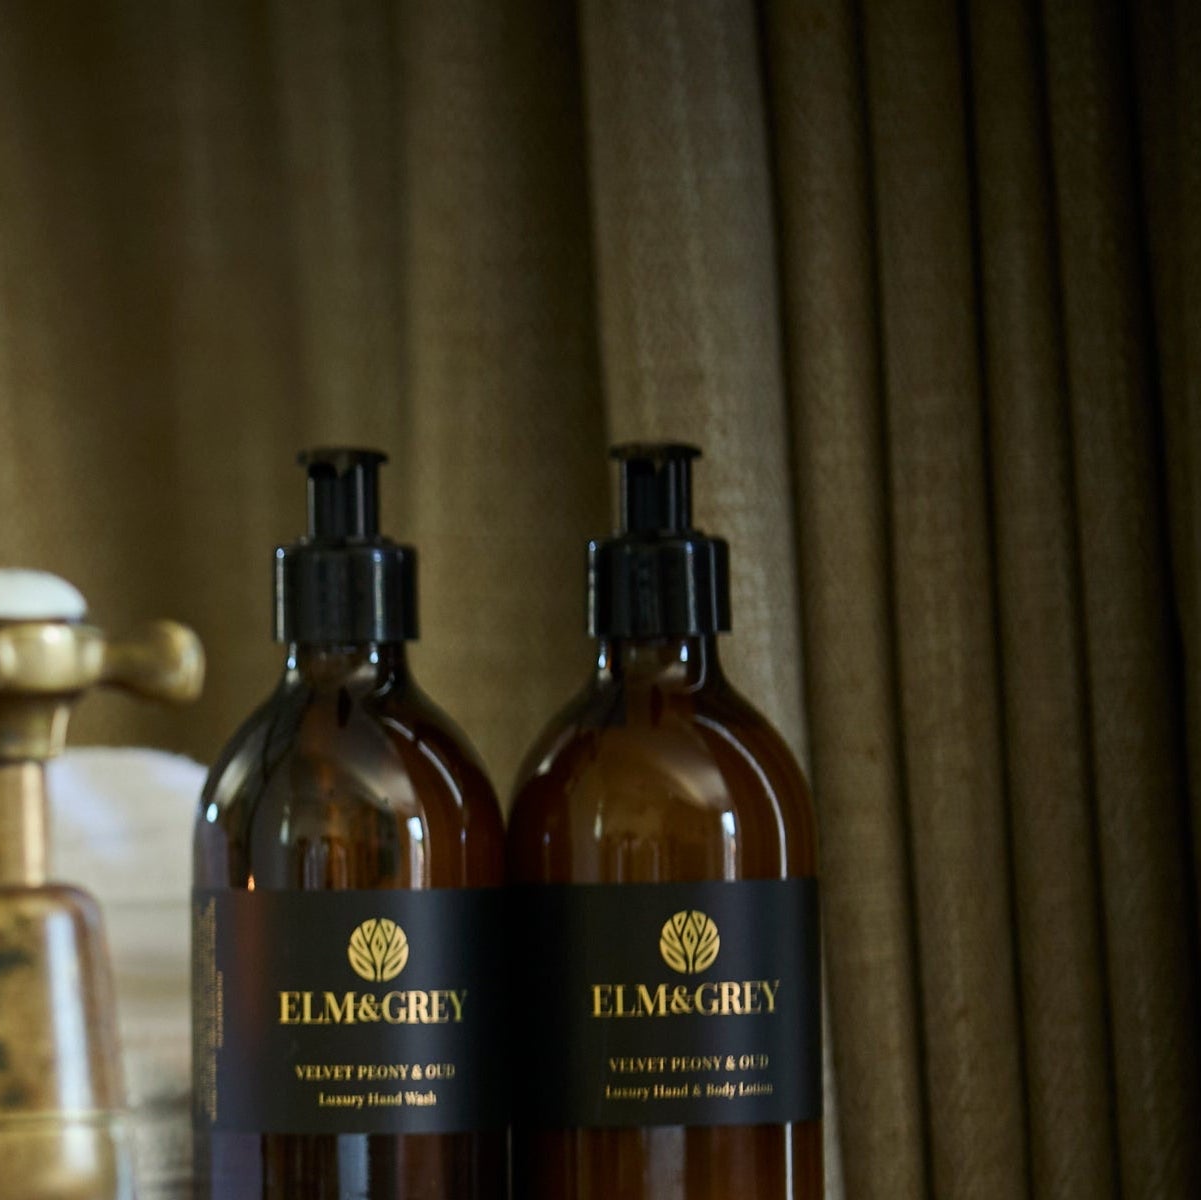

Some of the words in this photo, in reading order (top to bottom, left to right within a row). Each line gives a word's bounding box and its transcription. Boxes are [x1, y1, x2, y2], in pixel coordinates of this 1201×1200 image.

[279, 991, 467, 1024] ELM&GREY
[592, 980, 779, 1017] ELM&GREY
[295, 1065, 353, 1081] VELVET
[357, 1065, 409, 1081] PEONY
[411, 1064, 422, 1080] &
[425, 1063, 455, 1080] OUD
[609, 1056, 667, 1073] VELVET
[671, 1055, 722, 1072] PEONY
[725, 1054, 736, 1071] &
[739, 1053, 769, 1070] OUD
[318, 1092, 365, 1109] Luxury
[368, 1092, 402, 1107] Hand
[404, 1090, 437, 1106] Wash
[605, 1084, 650, 1101] Luxury
[653, 1084, 688, 1099] Hand
[693, 1083, 701, 1097] &
[706, 1082, 737, 1100] Body
[738, 1081, 773, 1096] Lotion
